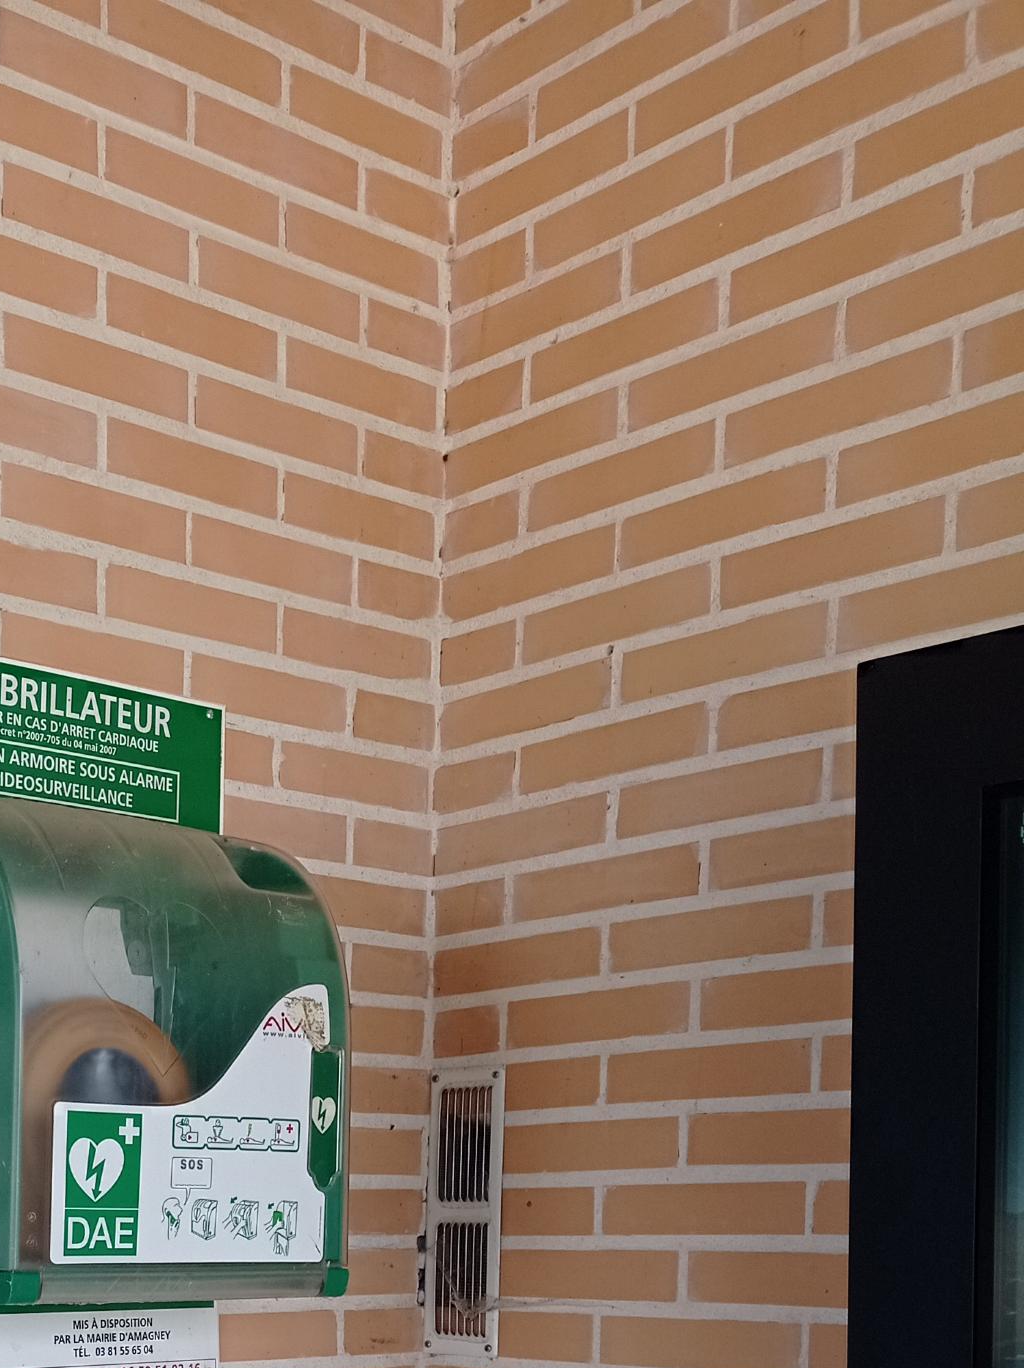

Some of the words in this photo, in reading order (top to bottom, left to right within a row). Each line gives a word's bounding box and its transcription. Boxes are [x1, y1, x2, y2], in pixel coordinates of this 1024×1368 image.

[7, 712, 22, 727] EN
[25, 716, 47, 731] CAS
[50, 720, 96, 740] D'ARRET
[98, 731, 159, 753] CARDIAQUE
[62, 737, 72, 748] du
[74, 739, 83, 750] 04
[85, 742, 98, 752] mai
[99, 744, 117, 756] 2007
[9, 750, 76, 776] ARMOIRE
[79, 762, 116, 783] SOUS
[118, 769, 173, 793] ALARME
[180, 1159, 204, 1170] SOS
[66, 1217, 134, 1250] DAE
[73, 1319, 89, 1330] MIS
[91, 1317, 99, 1329] À
[100, 1317, 153, 1329] DISPOSITION
[53, 1335, 71, 1345] PAR
[73, 1334, 84, 1344] LA
[87, 1332, 117, 1343] MAIRIE
[119, 1330, 171, 1342] D'AMAGNEY
[73, 1346, 90, 1358] TÉL.
[95, 1346, 106, 1357] 03
[107, 1346, 118, 1356] 81
[119, 1345, 130, 1356] 55
[131, 1345, 142, 1355] 65
[143, 1344, 153, 1355] 04
